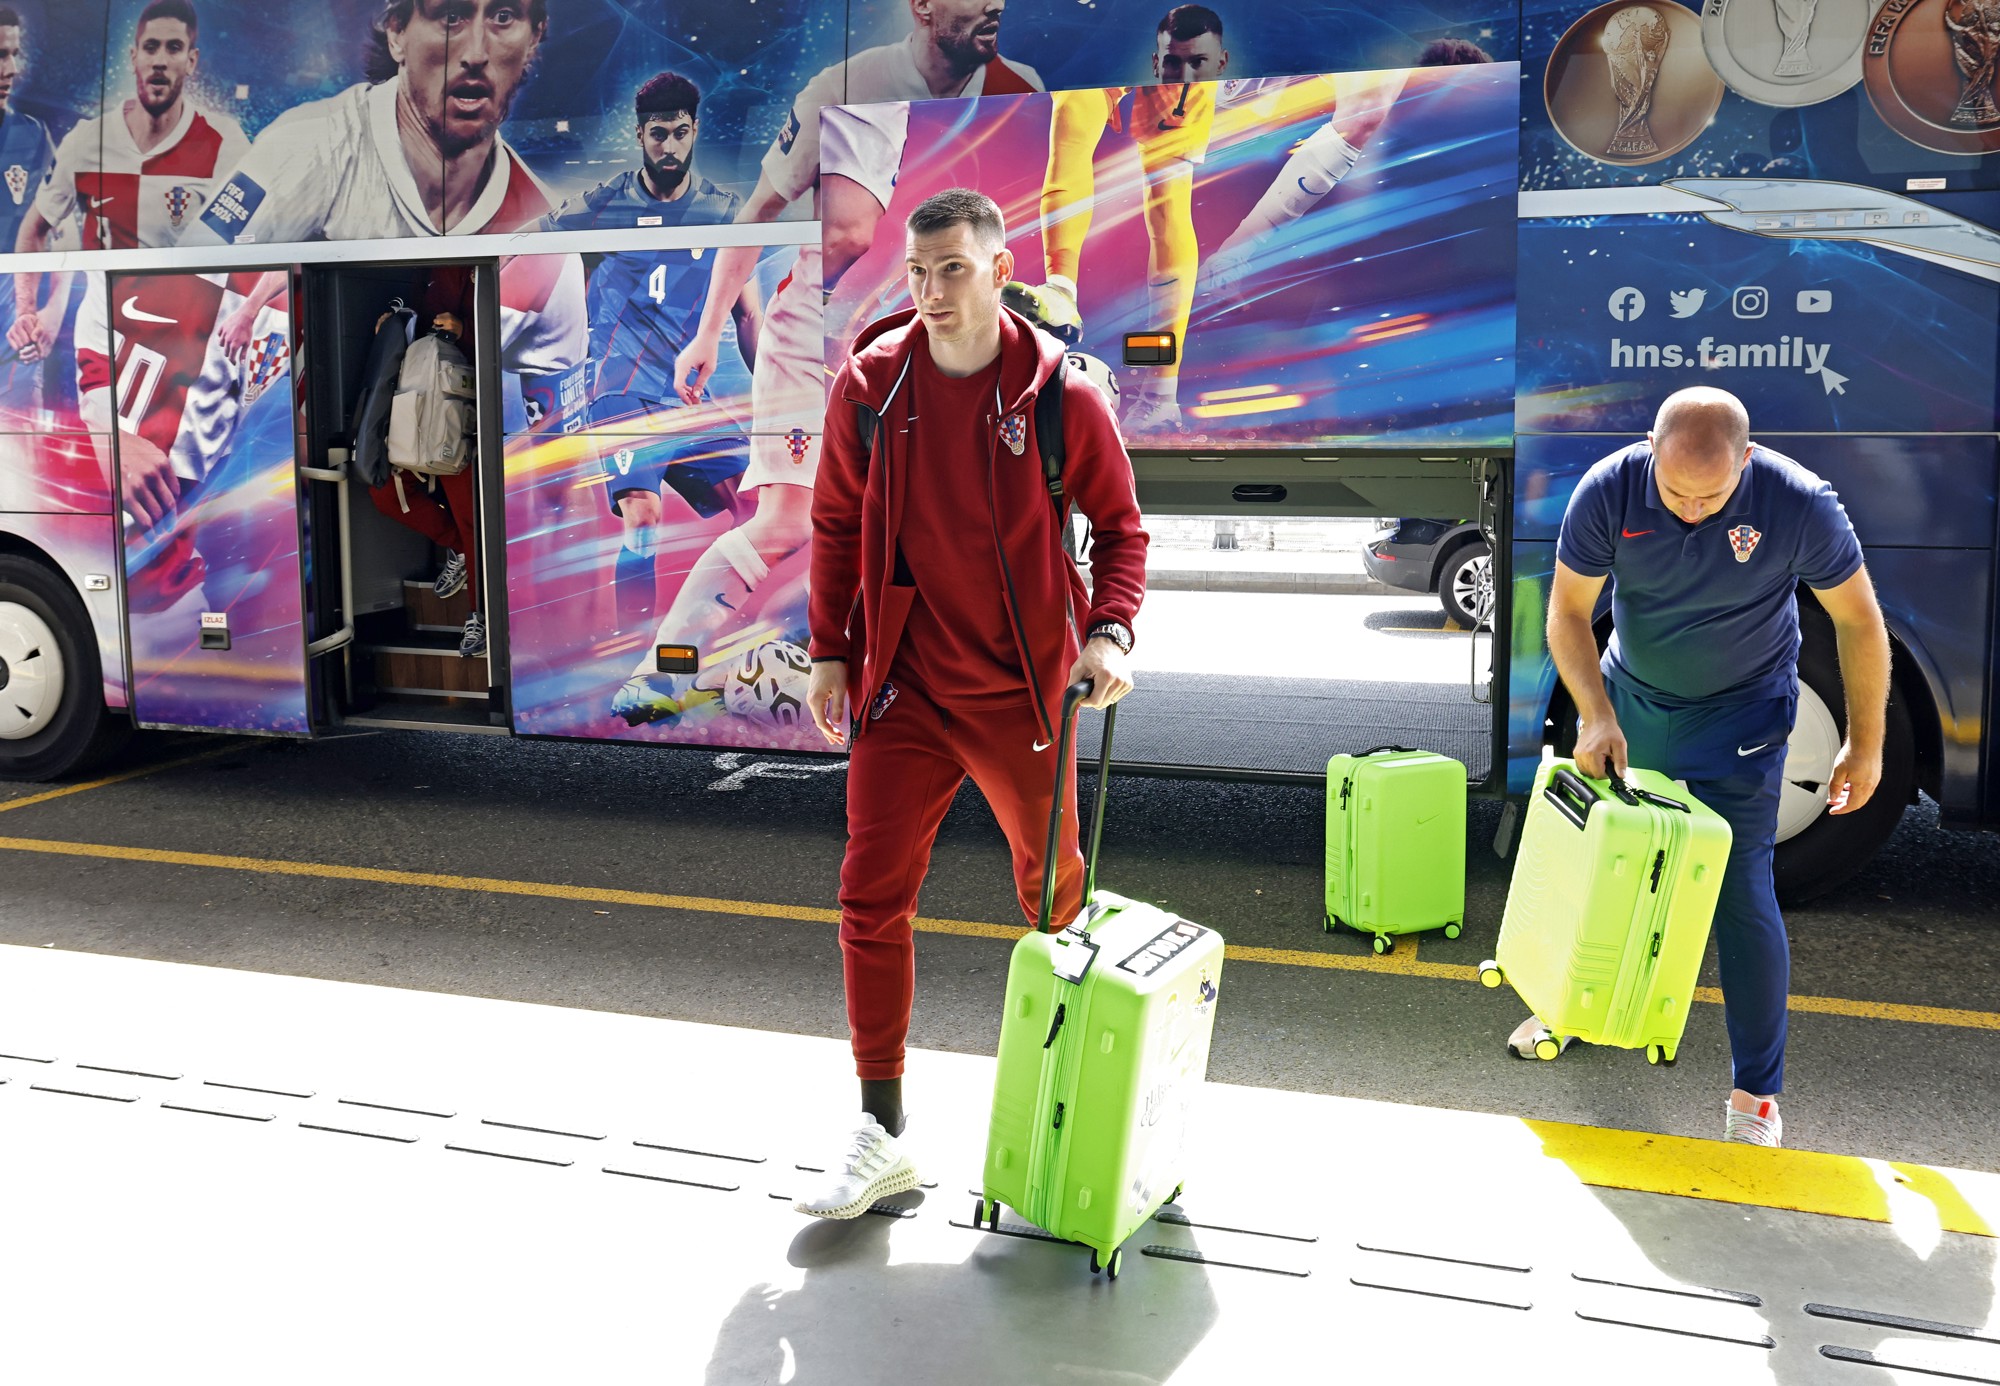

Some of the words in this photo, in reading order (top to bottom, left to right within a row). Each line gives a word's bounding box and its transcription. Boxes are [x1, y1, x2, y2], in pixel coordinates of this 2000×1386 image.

[1869, 16, 1897, 56] FIFA
[217, 193, 249, 221] SERIES
[225, 182, 245, 203] FIFA
[1755, 211, 1929, 229] SETRA
[648, 264, 667, 305] 4
[1610, 335, 1831, 375] hns.family
